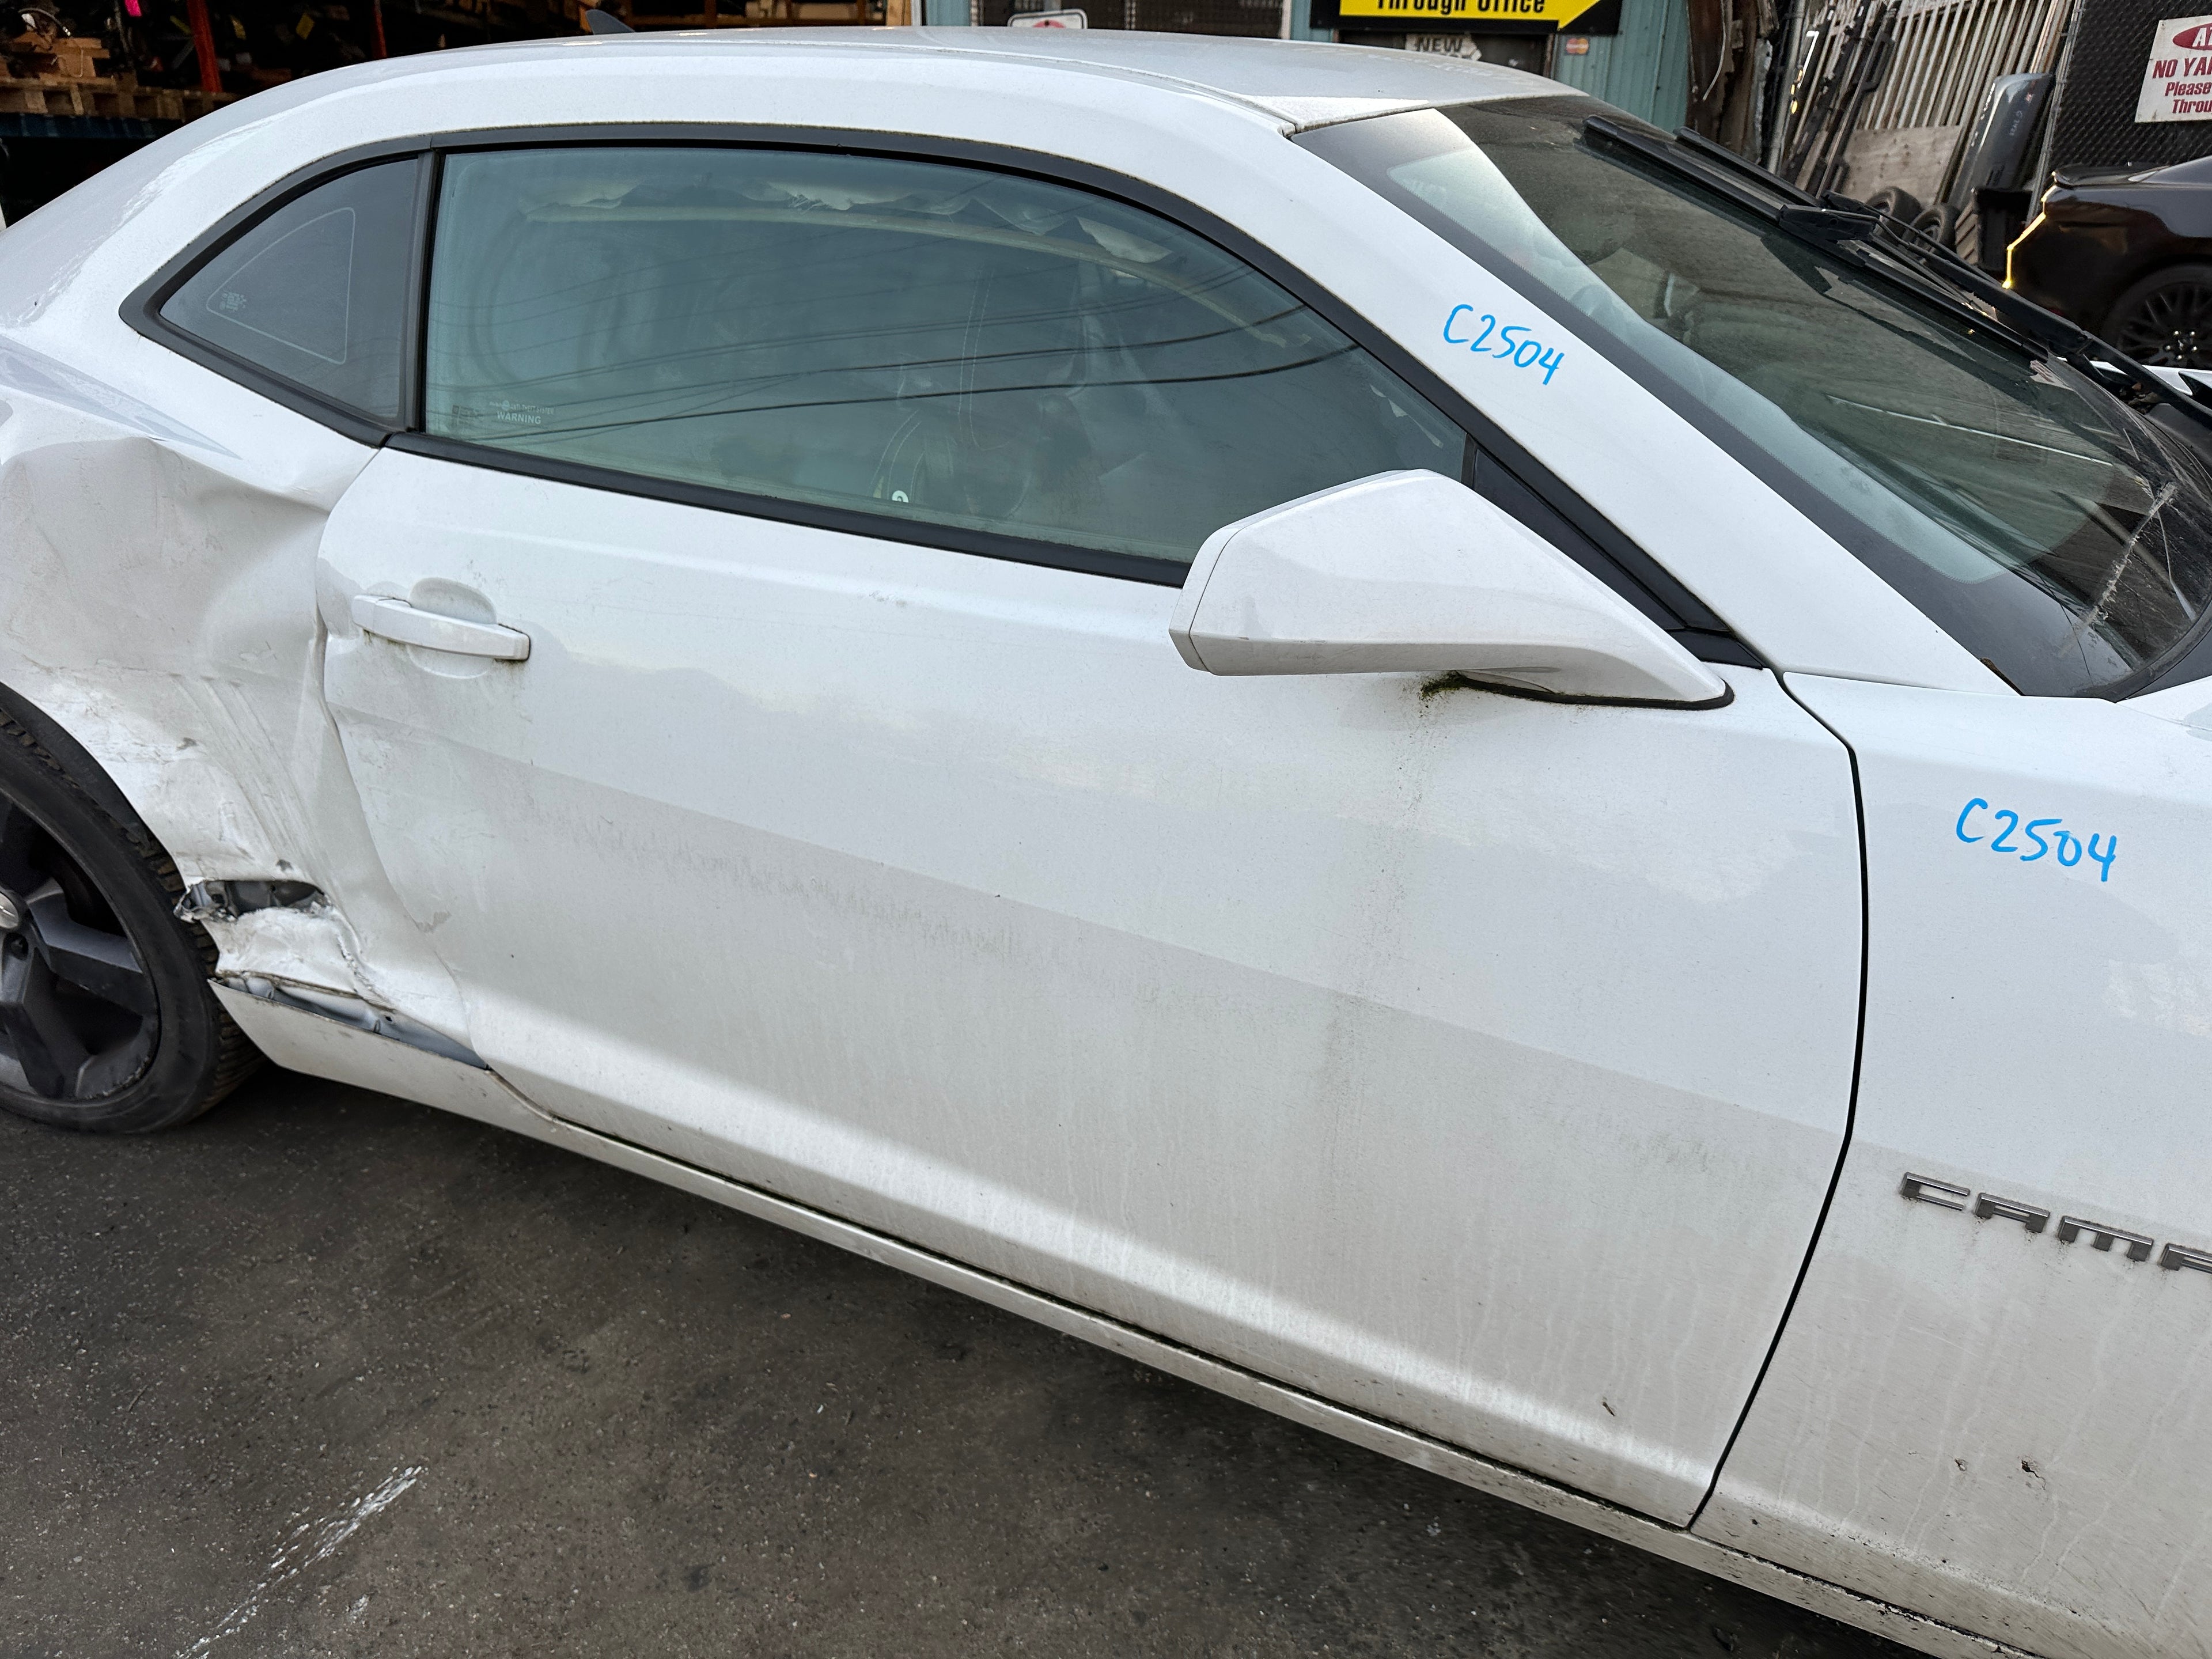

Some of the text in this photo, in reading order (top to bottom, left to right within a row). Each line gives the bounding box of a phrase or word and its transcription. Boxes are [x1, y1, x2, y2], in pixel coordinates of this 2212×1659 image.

[1415, 36, 1463, 52] NEW
[2152, 59, 2179, 79] NO
[2164, 81, 2212, 97] Please
[1443, 304, 1565, 385] C2504
[497, 410, 542, 425] WARNING
[1956, 797, 2117, 882] C2504
